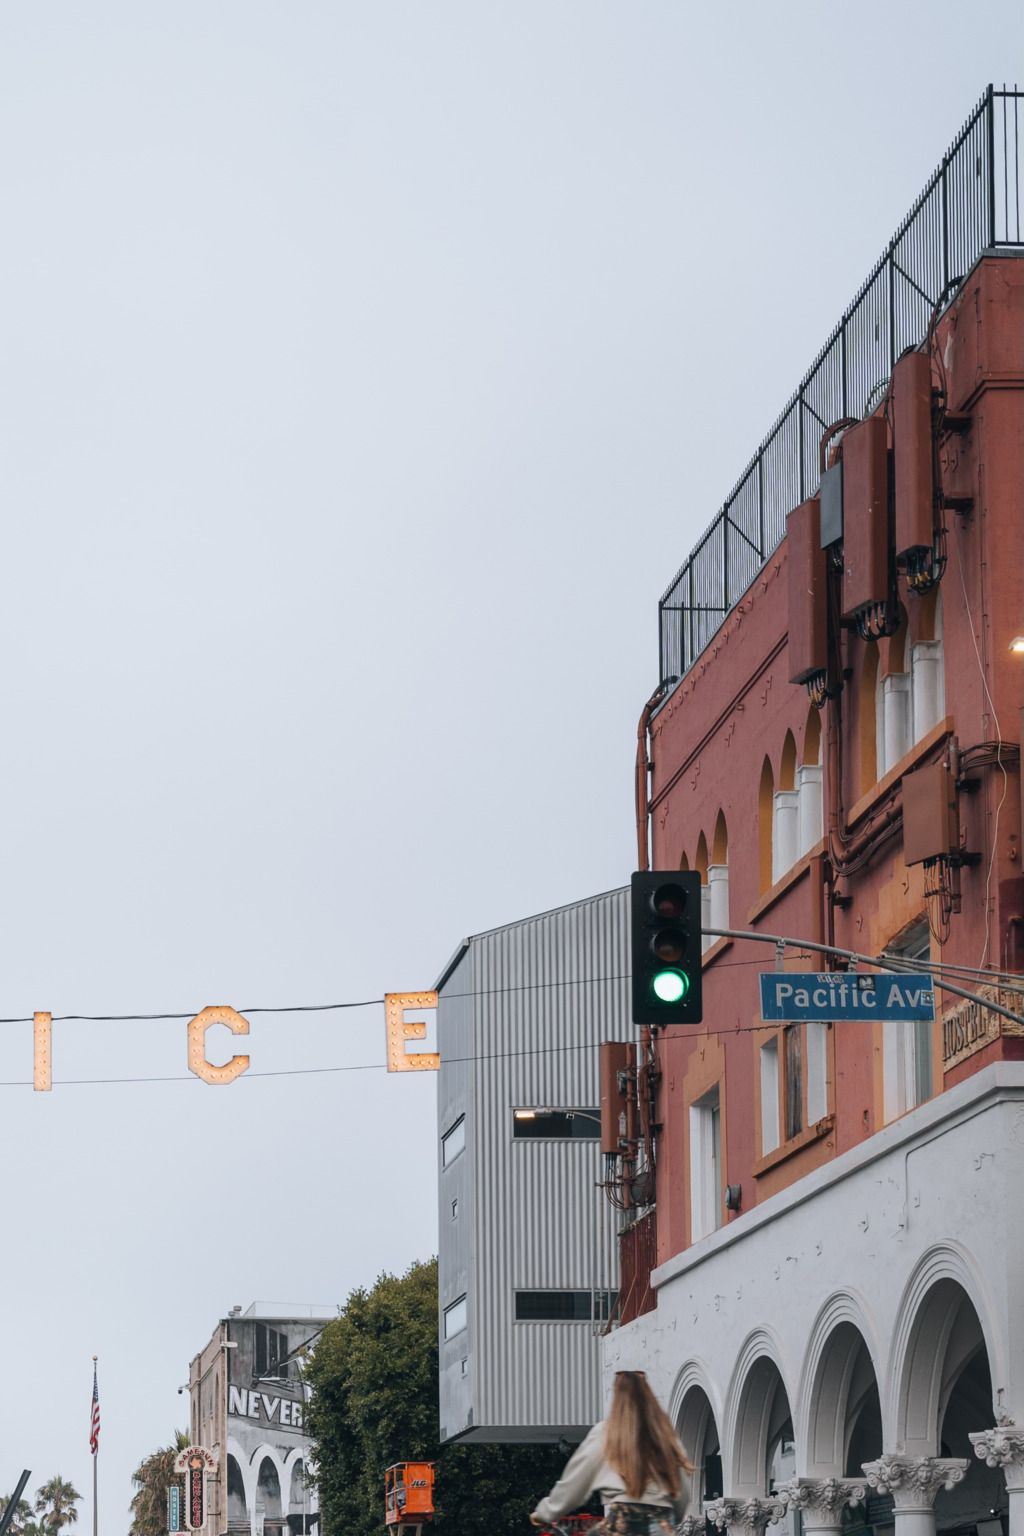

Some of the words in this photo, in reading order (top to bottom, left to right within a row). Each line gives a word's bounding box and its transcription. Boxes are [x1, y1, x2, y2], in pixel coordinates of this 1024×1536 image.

[775, 982, 877, 1008] Pacific
[886, 984, 931, 1008] Av
[178, 1448, 215, 1468] SAMESUN
